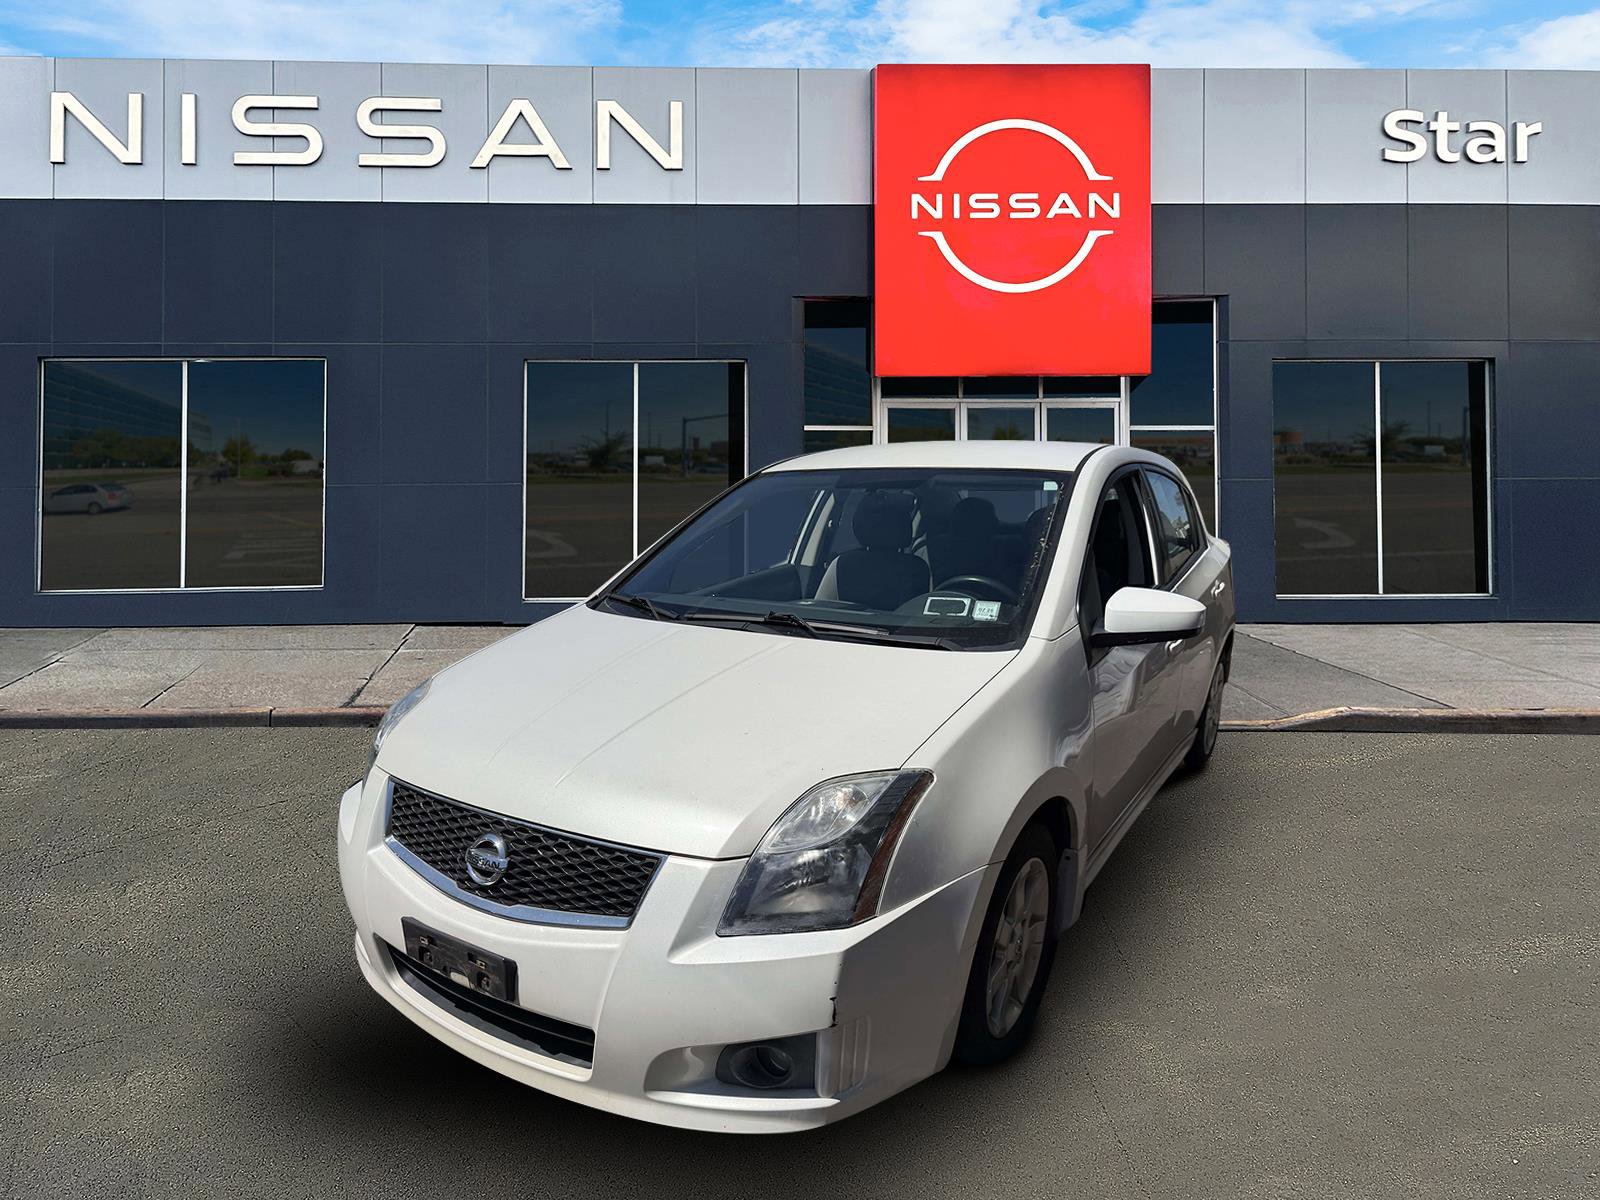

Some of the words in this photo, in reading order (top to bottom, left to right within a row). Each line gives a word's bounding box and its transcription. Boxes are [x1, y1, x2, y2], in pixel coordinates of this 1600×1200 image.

[50, 90, 684, 171] NISSAN
[1382, 108, 1543, 163] Star
[911, 192, 1121, 219] NISSAN
